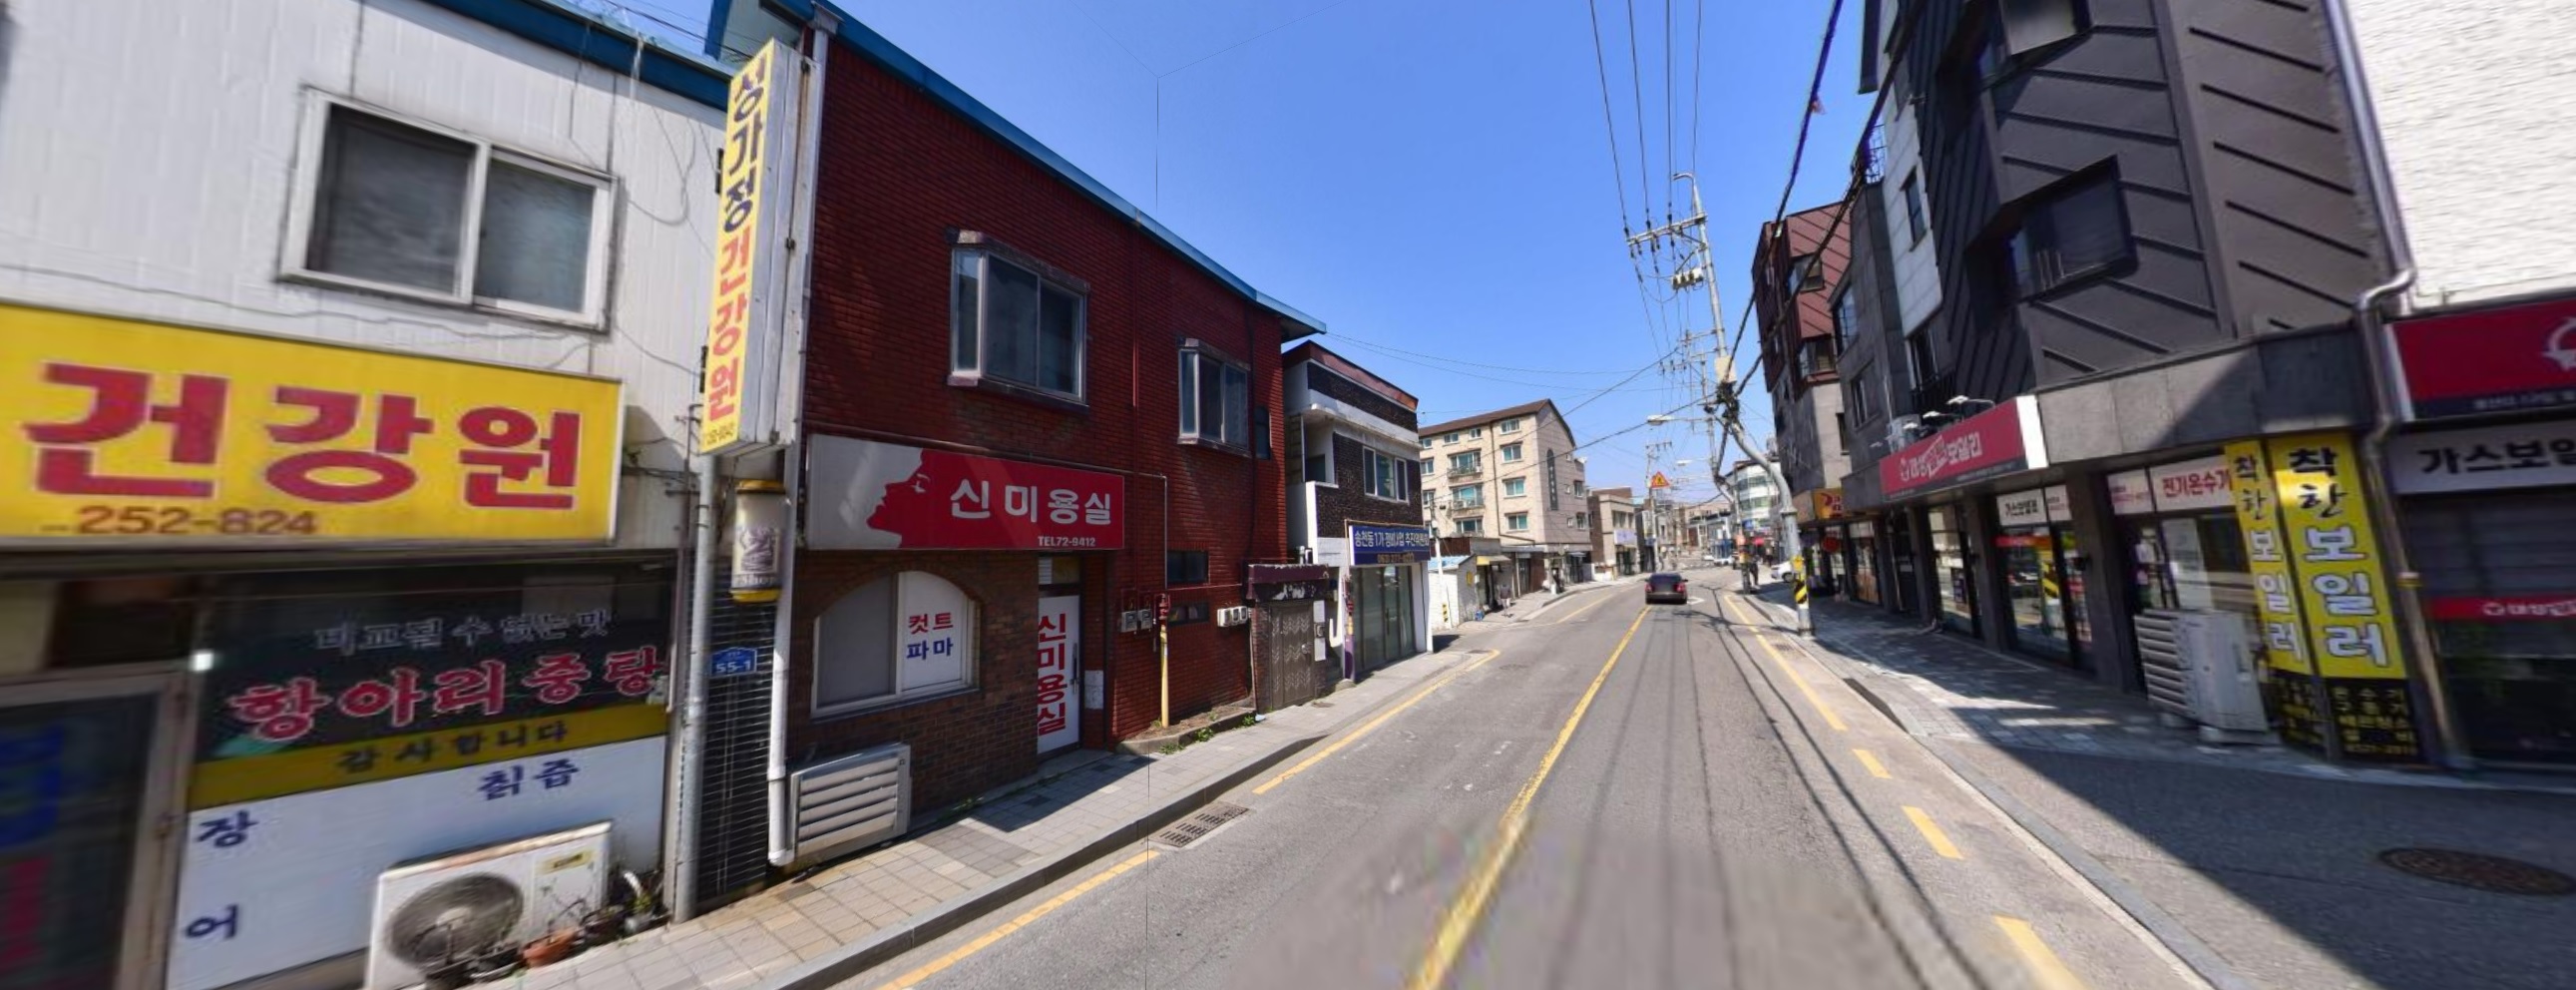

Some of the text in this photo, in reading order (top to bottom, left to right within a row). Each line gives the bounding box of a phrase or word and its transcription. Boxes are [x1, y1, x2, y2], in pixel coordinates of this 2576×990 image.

[22, 360, 581, 510] 건강원
[452, 617, 494, 647] 수
[908, 612, 954, 635] 컷트
[906, 637, 954, 661] 파마
[715, 659, 752, 675] 55-1
